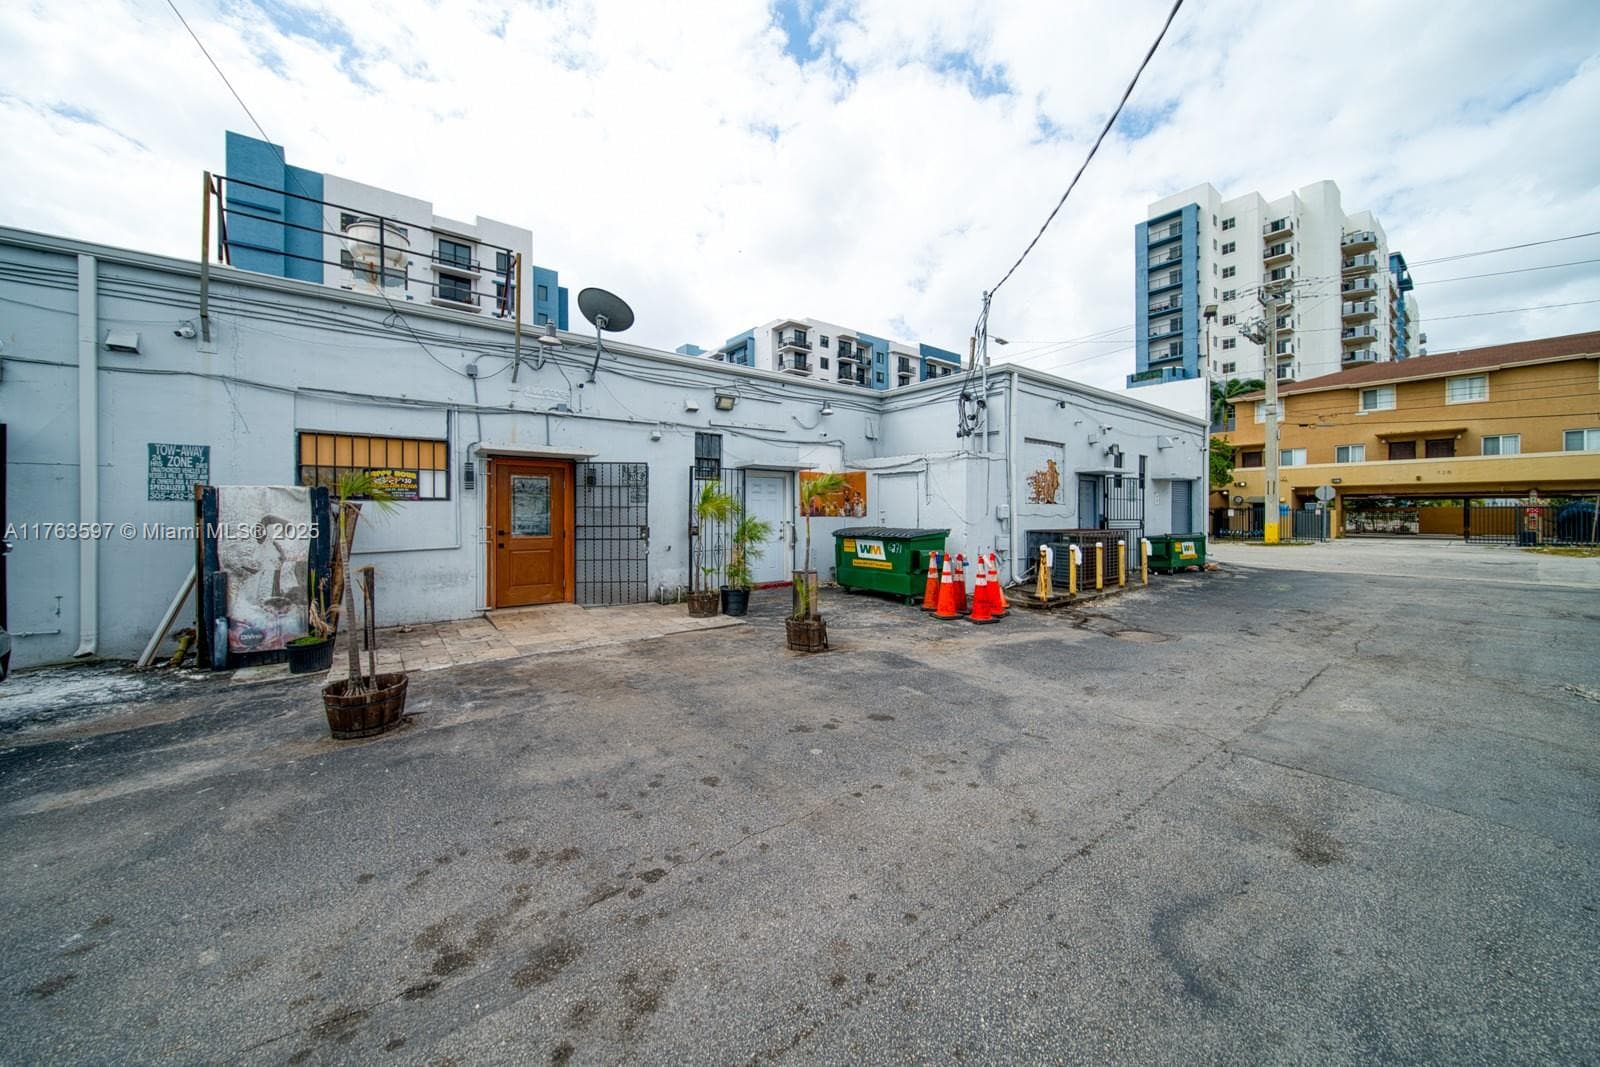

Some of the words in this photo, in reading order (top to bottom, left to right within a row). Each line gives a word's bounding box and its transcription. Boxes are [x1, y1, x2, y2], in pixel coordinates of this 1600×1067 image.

[155, 445, 204, 456] TOW-AWAY
[167, 456, 193, 468] ZONE
[859, 543, 882, 555] WM
